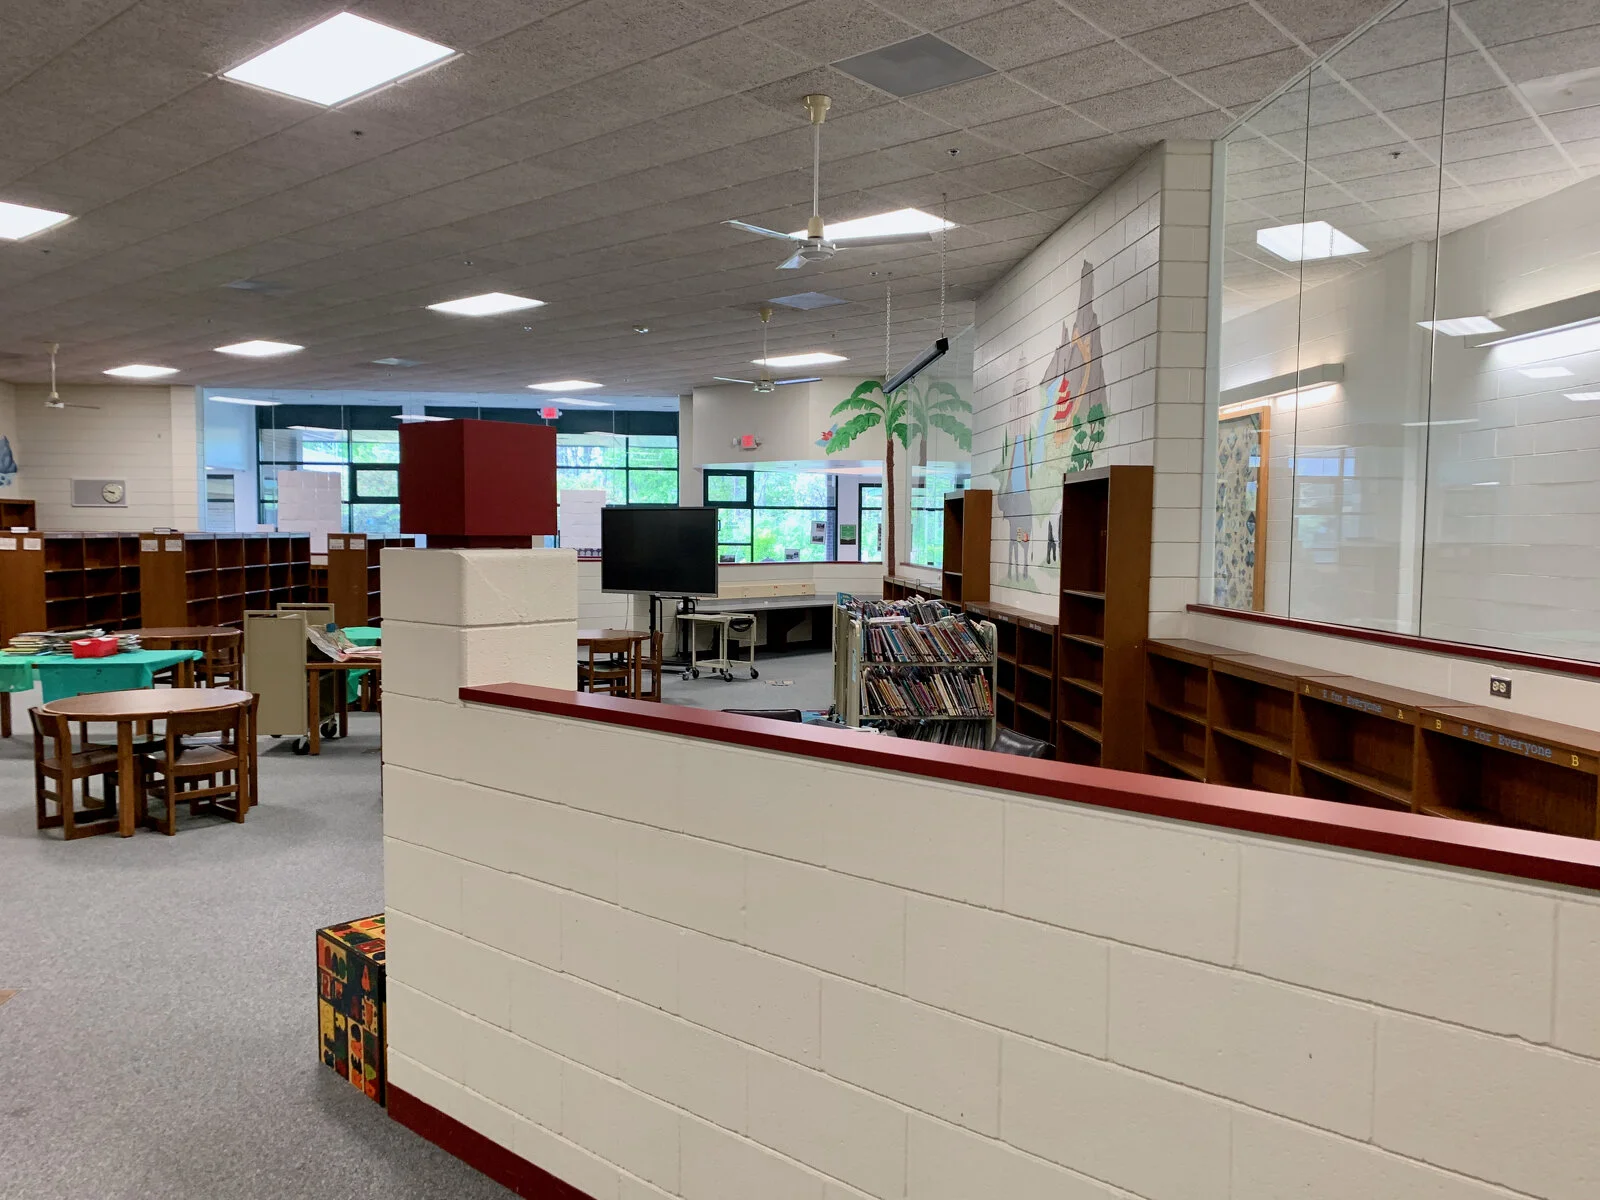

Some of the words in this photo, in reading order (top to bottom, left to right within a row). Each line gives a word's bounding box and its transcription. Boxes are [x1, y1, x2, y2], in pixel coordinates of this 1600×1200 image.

[1305, 684, 1310, 694] A
[1346, 695, 1382, 713] Everyone
[1397, 709, 1403, 719] A
[1435, 719, 1442, 730] B
[1474, 728, 1492, 742] for
[1498, 734, 1552, 758] Everyone
[1571, 754, 1580, 767] B
